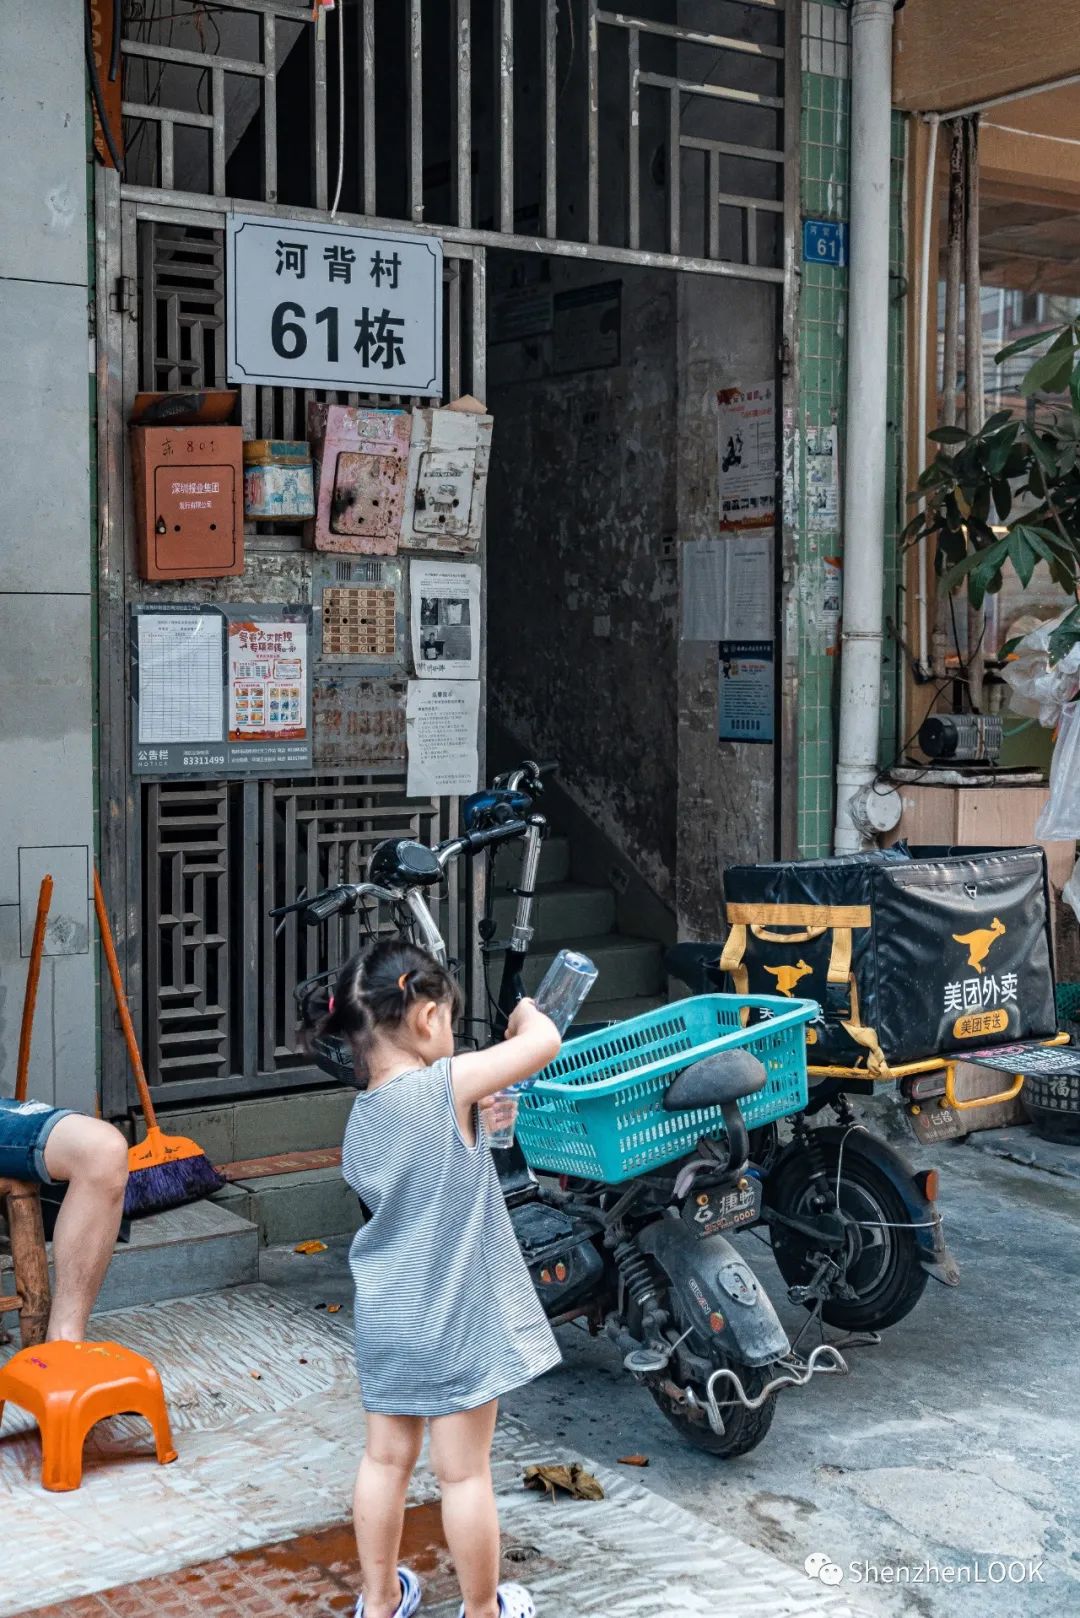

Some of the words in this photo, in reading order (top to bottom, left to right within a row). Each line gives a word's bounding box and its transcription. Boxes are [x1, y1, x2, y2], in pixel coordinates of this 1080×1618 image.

[817, 239, 836, 257] 61
[275, 240, 402, 289] 河背村
[271, 301, 406, 370] 61栋
[171, 482, 219, 494] 深圳报业集团
[138, 749, 169, 761] 公告栏
[183, 756, 225, 766] 83311499
[944, 972, 1018, 1013] 美团外卖
[960, 1012, 1001, 1035] 美团专送
[1049, 1076, 1070, 1097] 福
